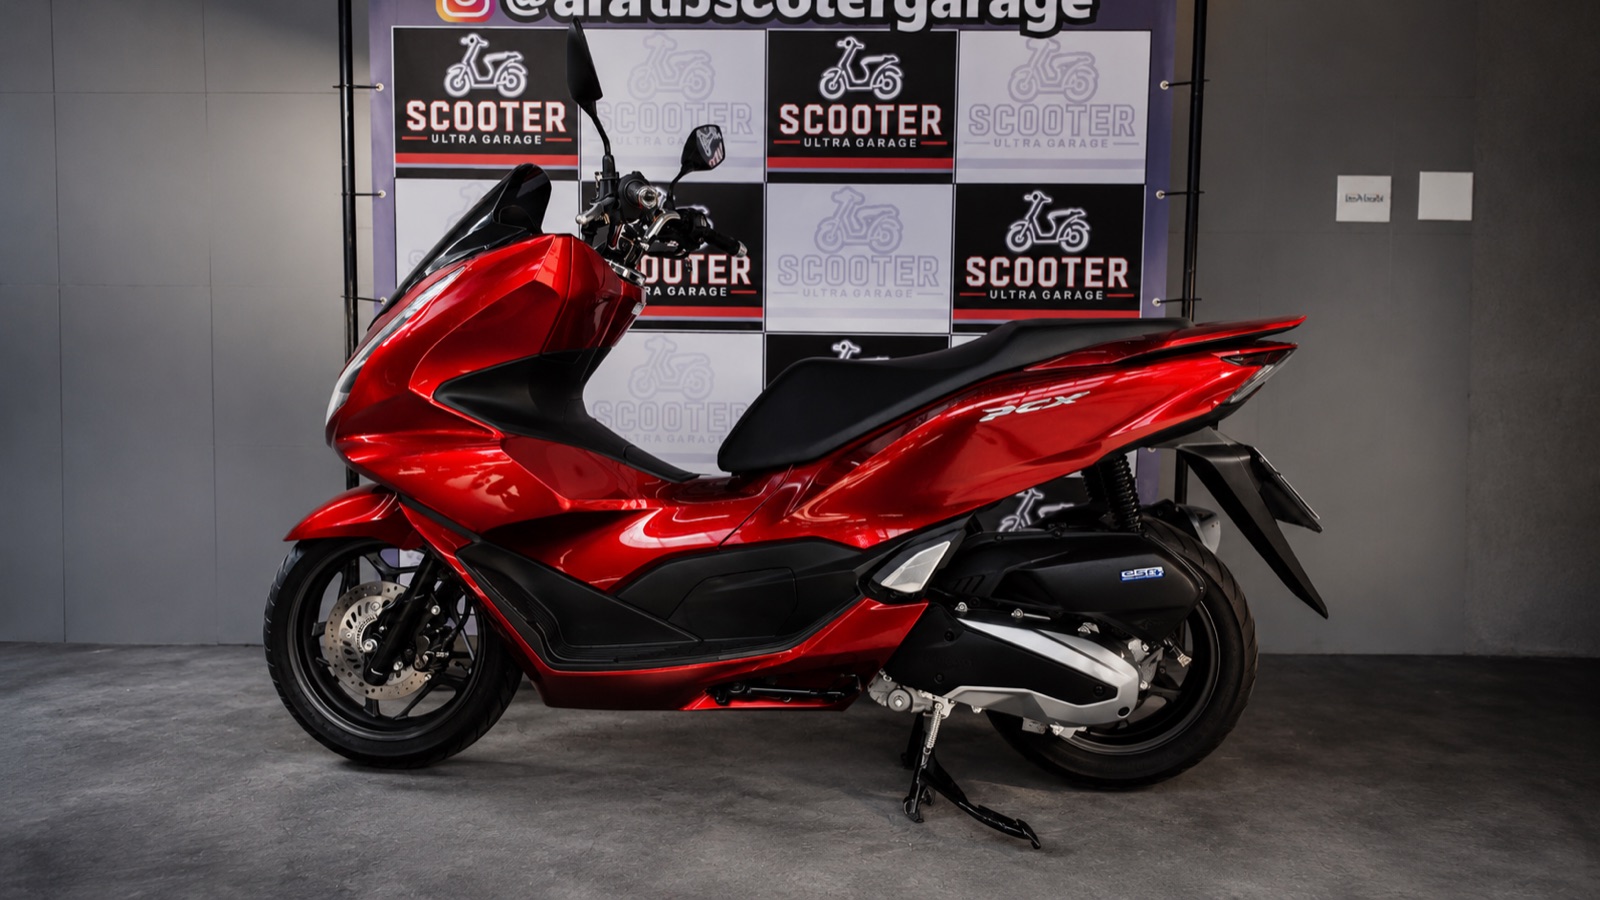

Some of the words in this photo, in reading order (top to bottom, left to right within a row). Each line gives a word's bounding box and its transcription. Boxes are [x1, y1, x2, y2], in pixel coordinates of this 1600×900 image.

[406, 100, 567, 133] SCOOTER
[780, 103, 942, 136] SCOOTER
[968, 103, 1136, 137] SCOOTER
[431, 134, 477, 144] ULTRA
[482, 134, 542, 145] GARAGE
[616, 136, 662, 146] ULTRA
[804, 138, 851, 147] ULTRA
[856, 138, 917, 148] GARAGE
[993, 138, 1041, 148] ULTRA
[1047, 138, 1108, 148] GARAGE
[637, 254, 752, 285] OOTER
[777, 254, 939, 287] SCOOTER
[966, 256, 1129, 288] SCOOTER
[667, 286, 727, 297] GARAGE
[802, 288, 848, 297] ULTRA
[853, 288, 913, 299] GARAGE
[990, 290, 1037, 300] ULTRA
[1042, 290, 1103, 300] GARAGE
[979, 391, 1091, 422] PCX
